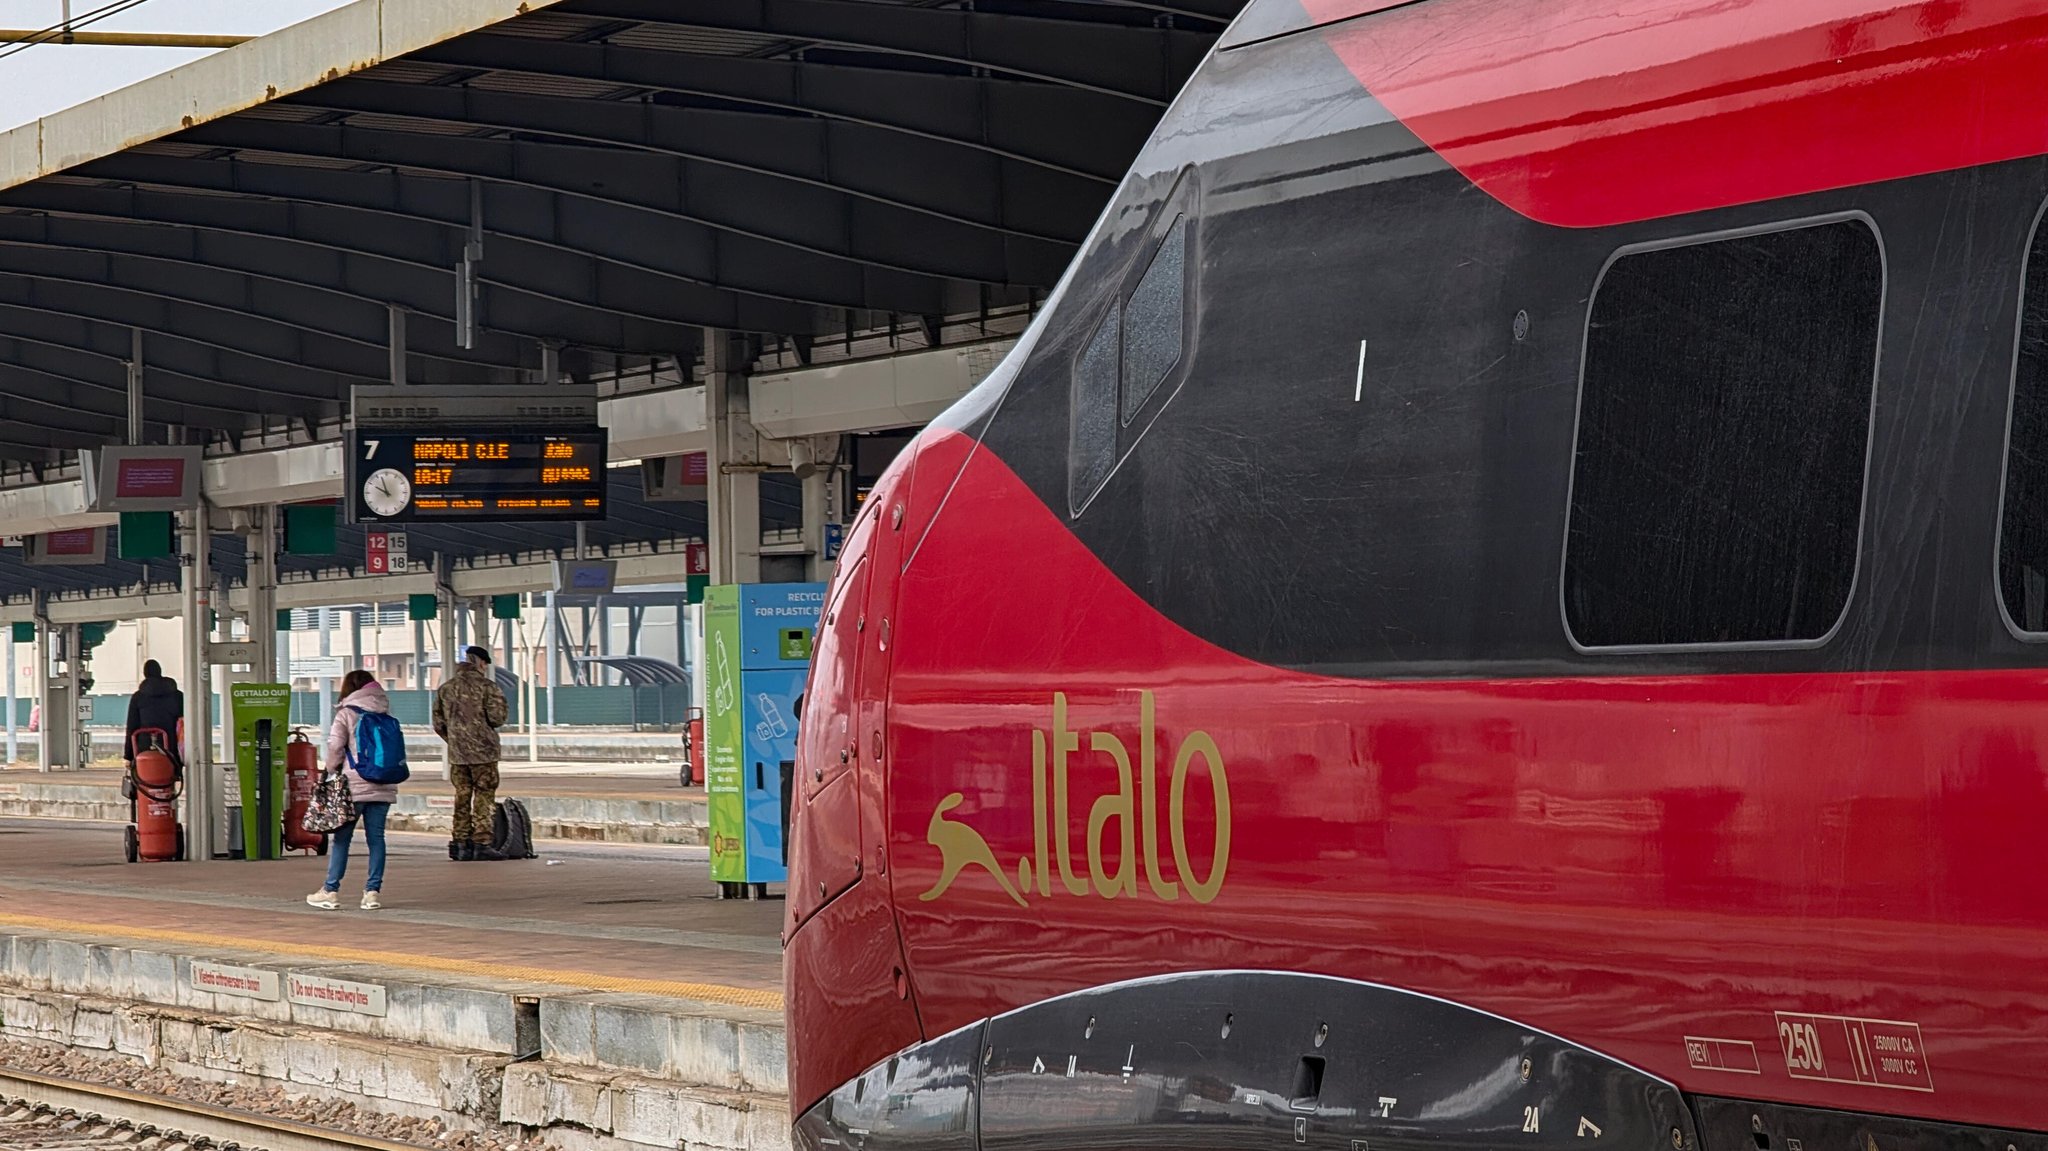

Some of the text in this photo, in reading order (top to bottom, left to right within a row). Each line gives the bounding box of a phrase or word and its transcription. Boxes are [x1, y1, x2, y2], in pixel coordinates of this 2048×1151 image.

[364, 440, 380, 460] 7
[414, 443, 470, 459] NAPOLI
[414, 469, 452, 485] 10:17
[369, 536, 406, 549] 12 15
[373, 557, 406, 569] 9 18
[755, 607, 774, 616] FOR
[776, 607, 812, 616] PLASTIC
[233, 689, 270, 697] GETTALO
[296, 979, 369, 1009] Do not cross the railway lines
[1688, 1042, 1708, 1063] REV
[1780, 1021, 1823, 1071] 250
[1873, 1035, 1915, 1053] 25000V CA
[1881, 1057, 1918, 1075] 3000V CC
[1522, 1105, 1539, 1133] 2A
